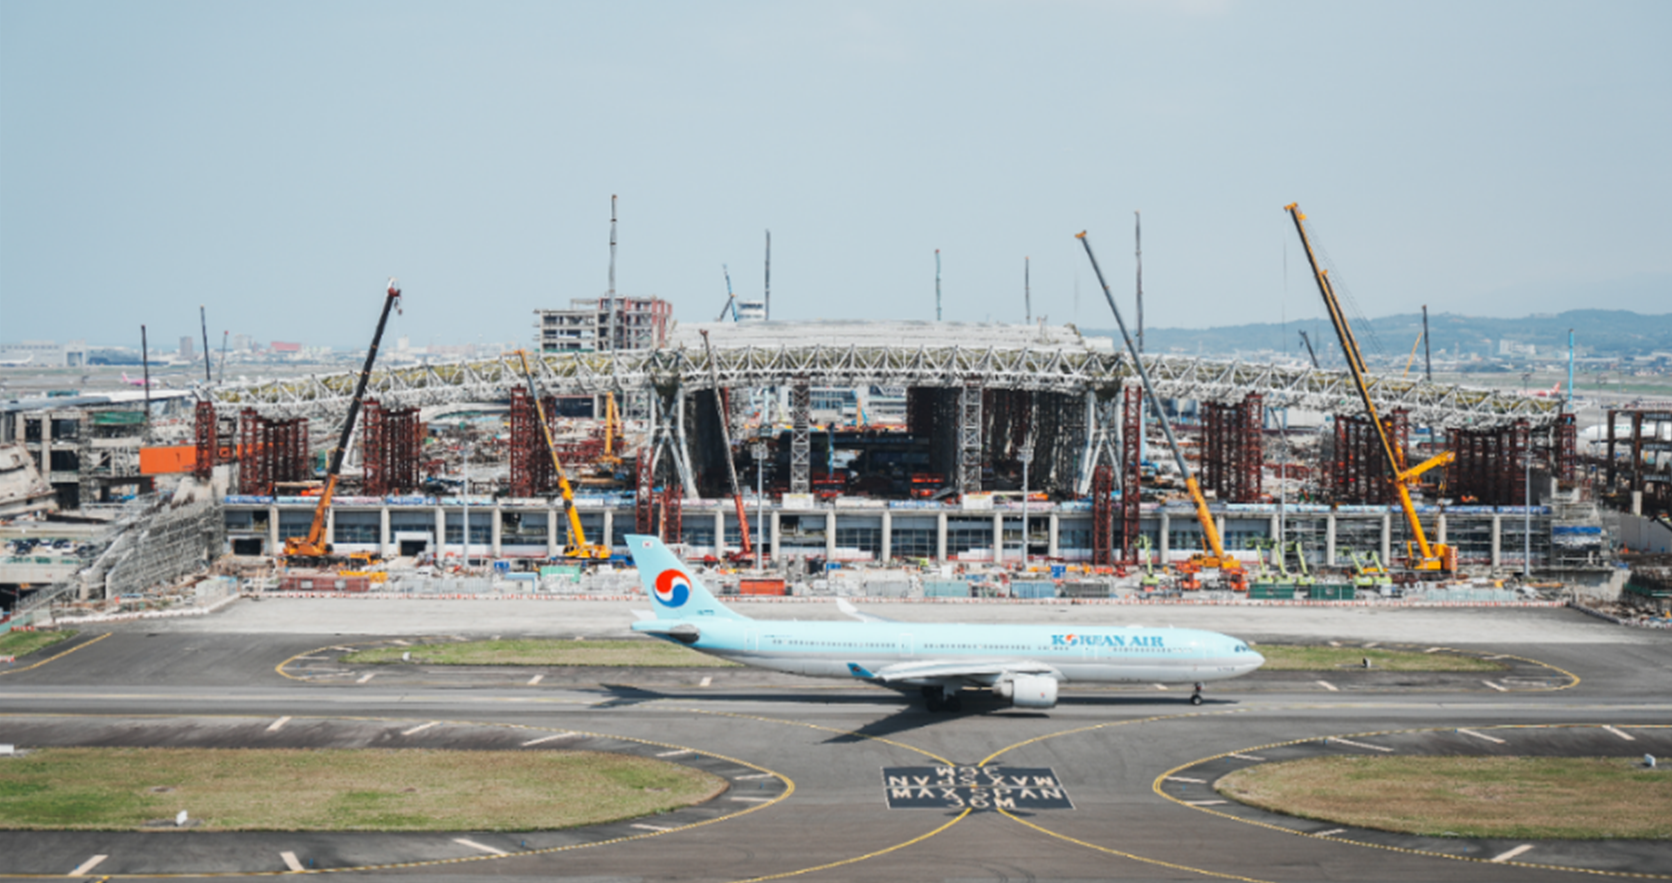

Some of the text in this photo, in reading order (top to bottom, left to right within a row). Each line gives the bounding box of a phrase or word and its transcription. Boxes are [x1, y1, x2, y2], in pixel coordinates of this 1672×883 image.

[1052, 634, 1164, 647] KOREAN AIR
[892, 788, 956, 798] MAX
